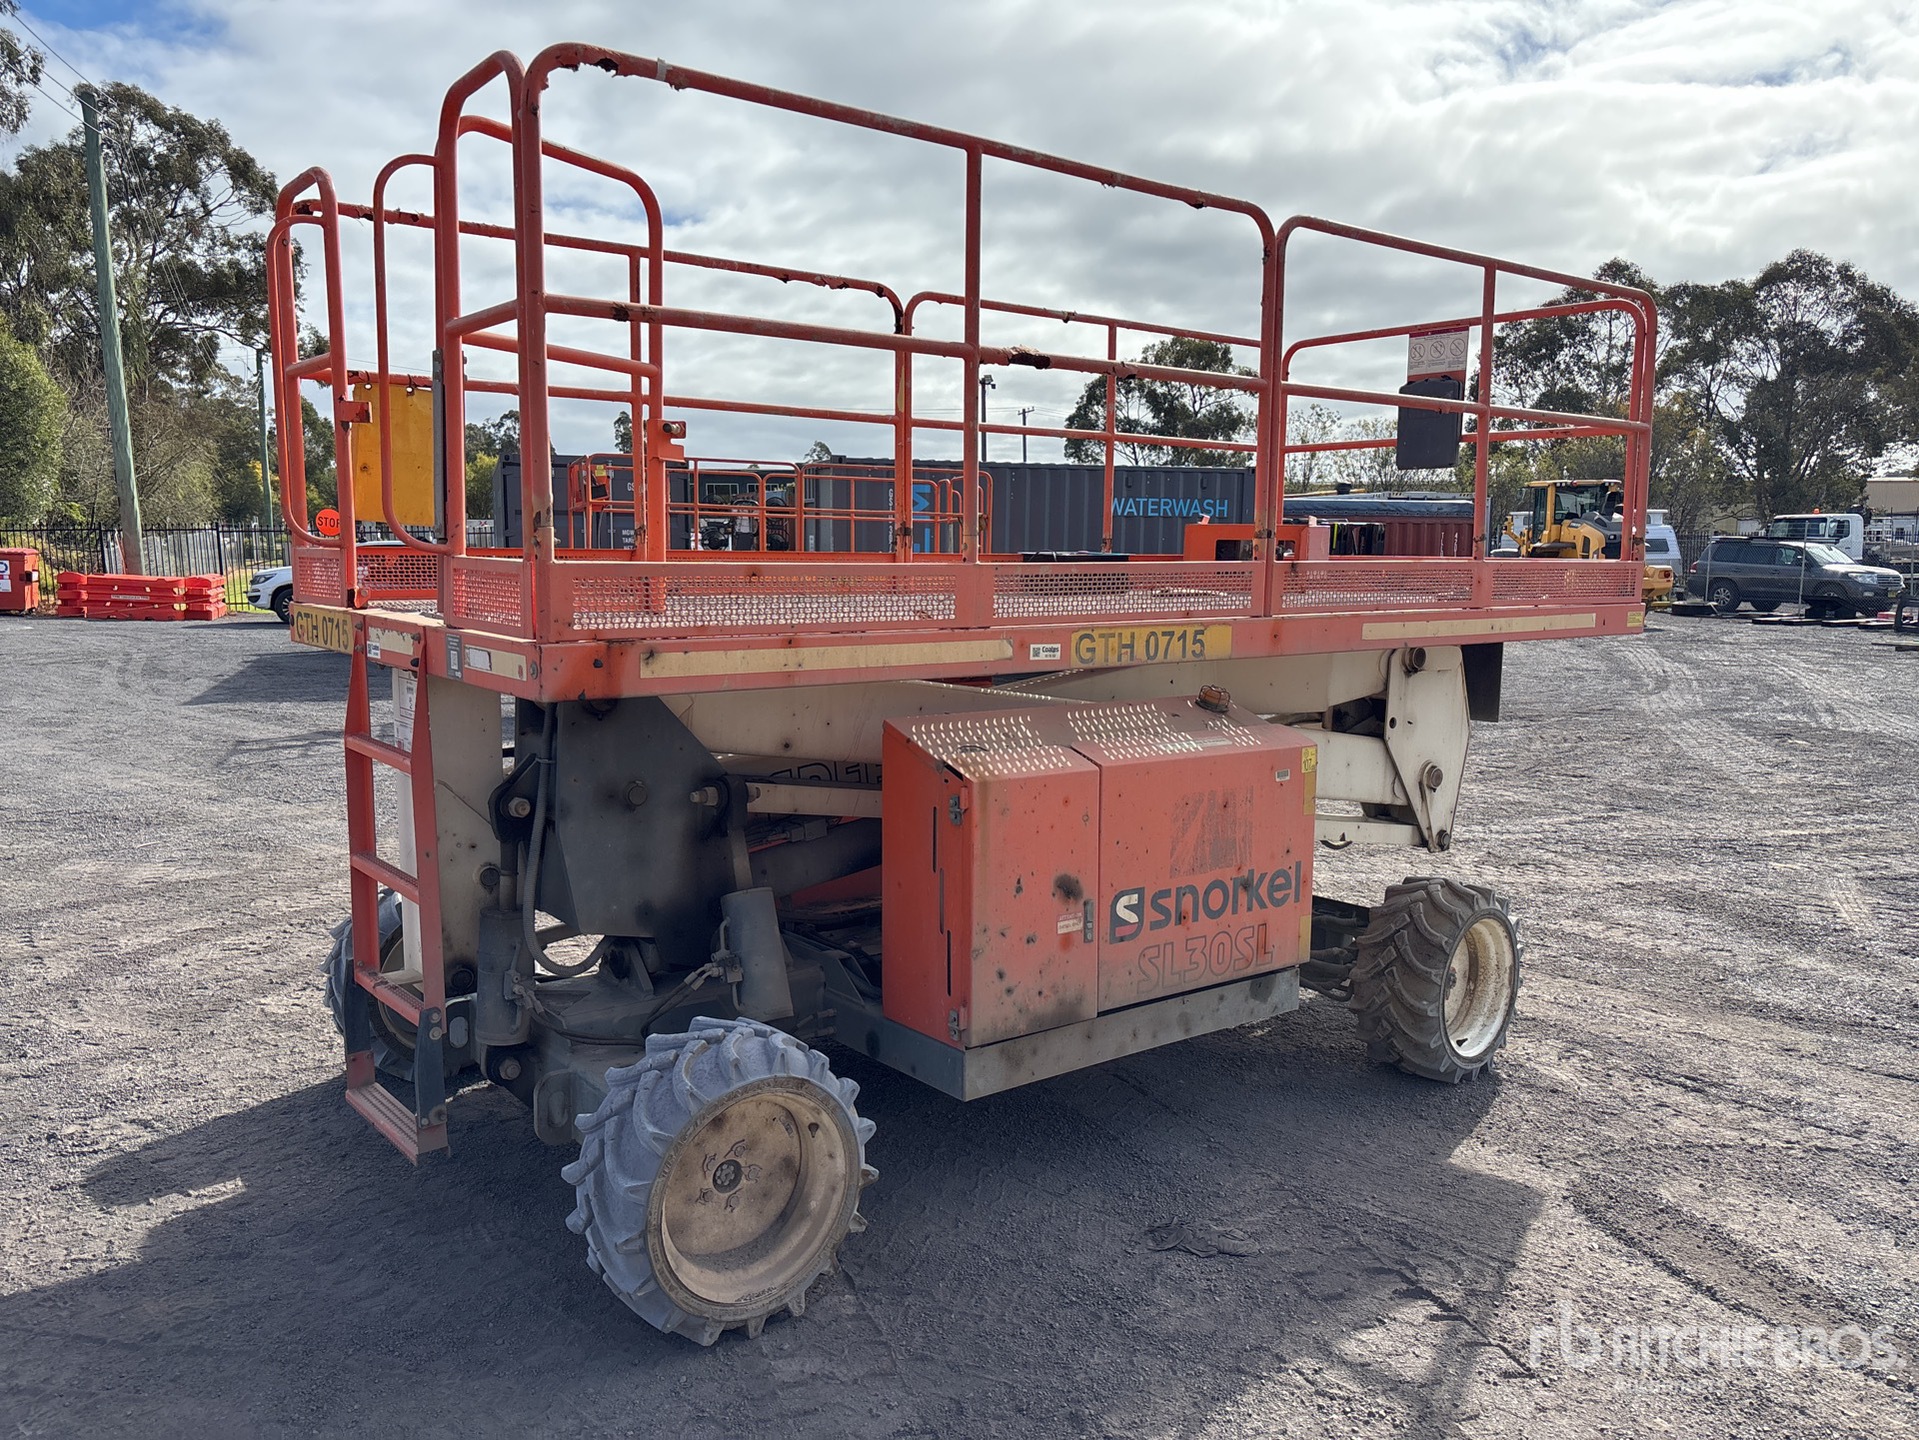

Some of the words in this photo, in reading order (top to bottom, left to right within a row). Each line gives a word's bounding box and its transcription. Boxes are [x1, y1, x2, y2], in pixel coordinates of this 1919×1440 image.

[1111, 498, 1228, 517] WATERWASH
[296, 611, 319, 643] GTH
[322, 616, 349, 650] 0715
[1075, 631, 1135, 664] GTH
[1145, 629, 1206, 661] 0715
[1149, 860, 1302, 931] snorkel
[1136, 922, 1274, 995] SL30SL
